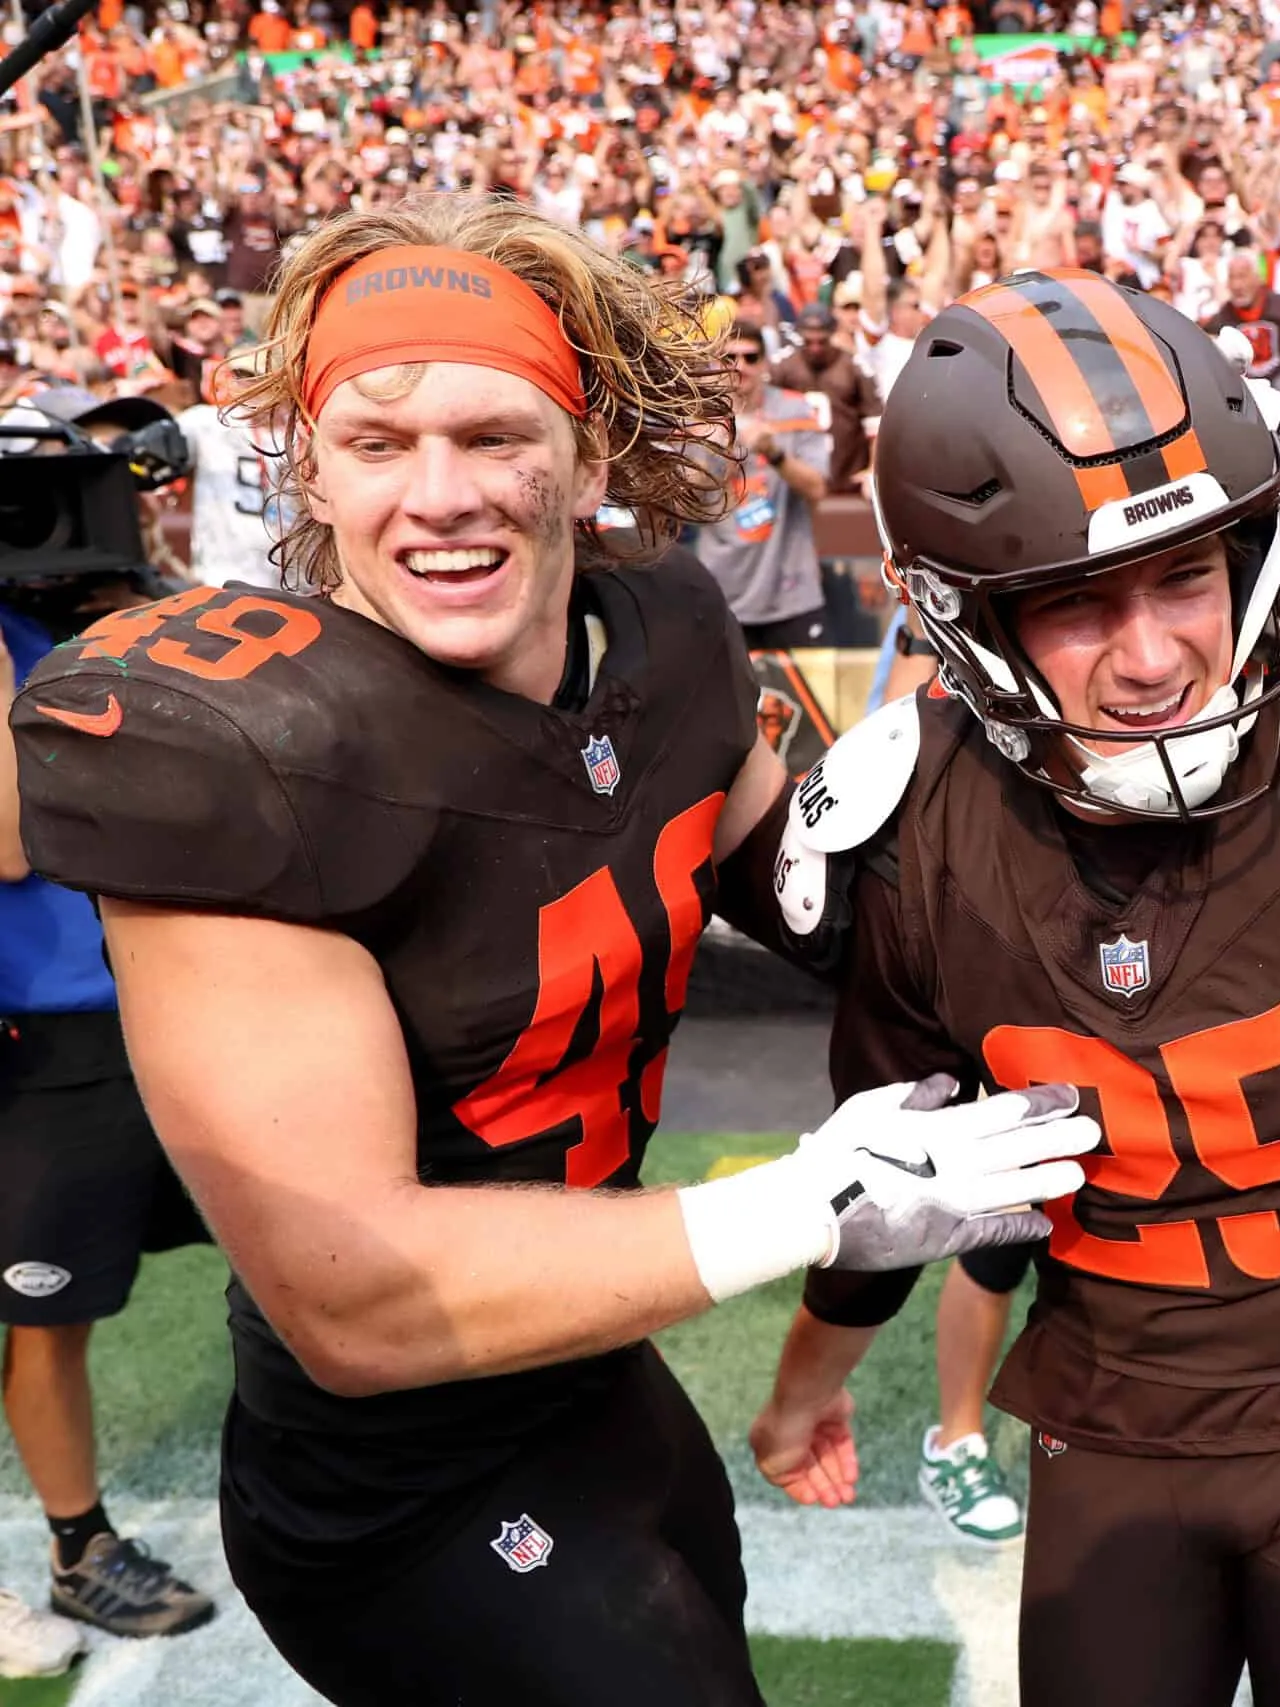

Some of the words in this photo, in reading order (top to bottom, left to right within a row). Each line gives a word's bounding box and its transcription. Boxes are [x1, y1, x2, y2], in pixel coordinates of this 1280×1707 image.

[345, 266, 492, 306] BROWNS
[1123, 485, 1194, 527] BROWNS
[79, 585, 322, 681] 49
[593, 760, 617, 785] NFL
[1108, 963, 1144, 987] NFL
[510, 1535, 546, 1565] NFL
